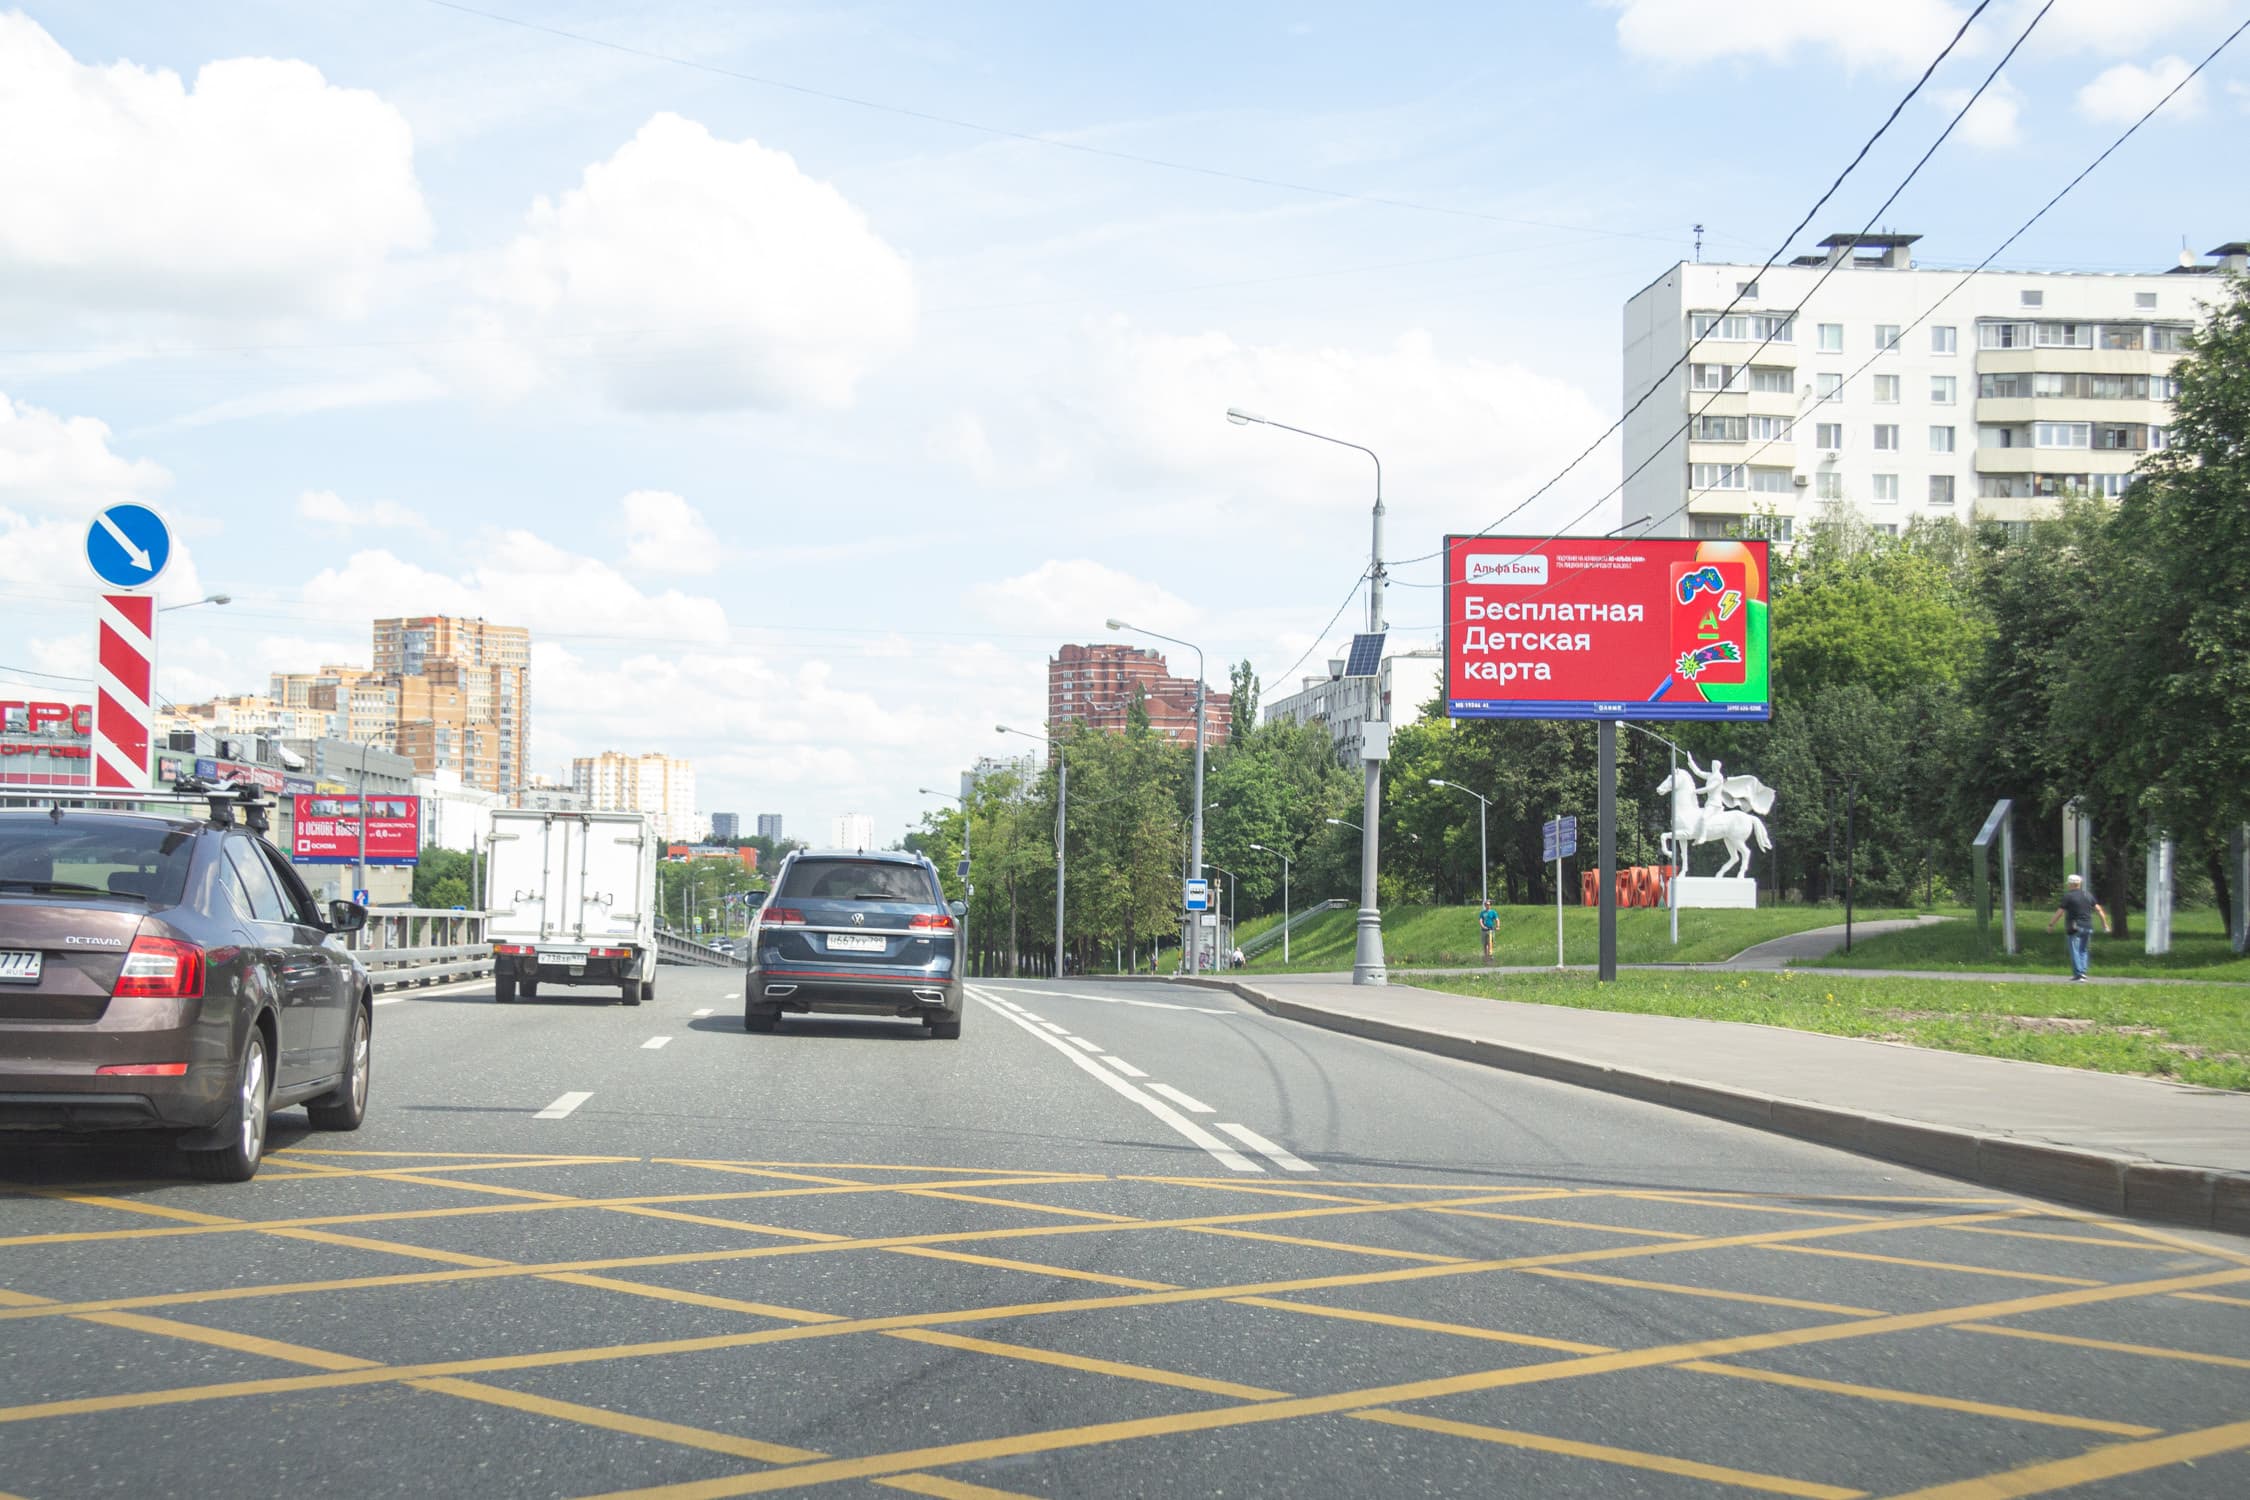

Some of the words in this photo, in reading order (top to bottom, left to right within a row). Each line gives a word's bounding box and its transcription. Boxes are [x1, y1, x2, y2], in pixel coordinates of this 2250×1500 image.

[1473, 562, 1510, 576] Альфа
[1512, 563, 1541, 575] Банк
[1464, 596, 1644, 623] Бесплатная
[1462, 626, 1591, 655] Детская
[1464, 661, 1552, 686] карта
[66, 936, 122, 946] OCTAVIA
